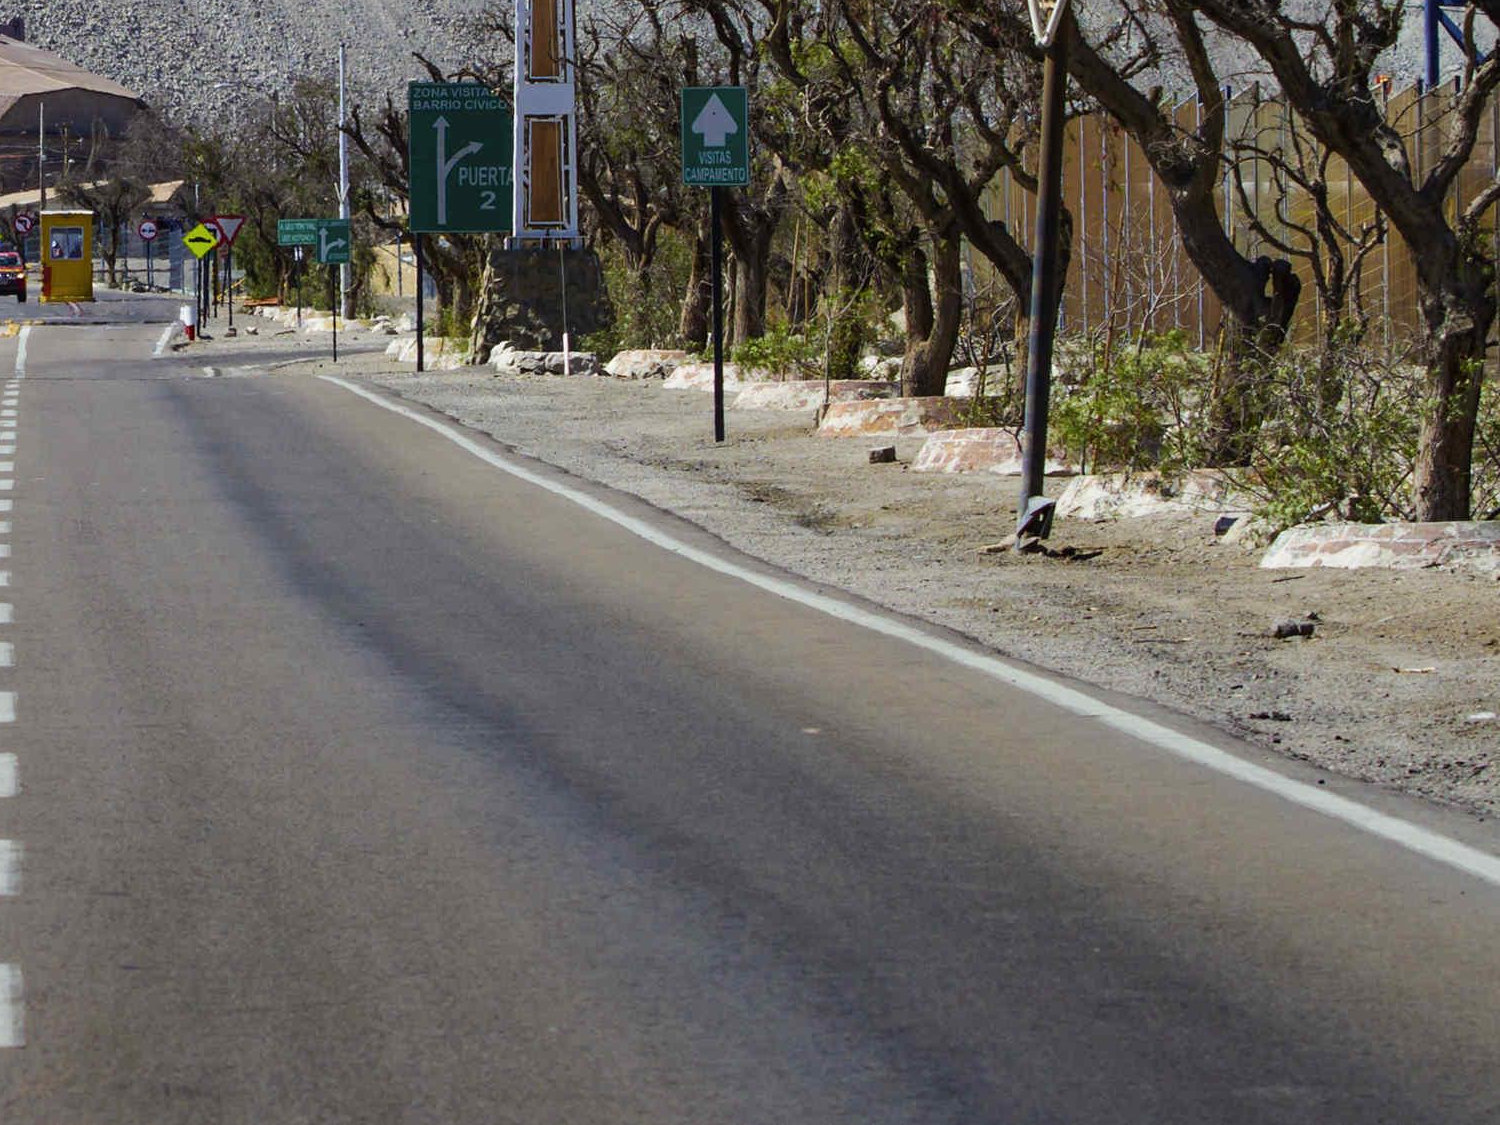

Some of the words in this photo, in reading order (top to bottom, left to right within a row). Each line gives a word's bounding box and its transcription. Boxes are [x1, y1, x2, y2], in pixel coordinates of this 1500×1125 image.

[412, 87, 449, 98] ZONA
[451, 87, 491, 98] VISITA
[412, 100, 461, 110] BARRIO
[698, 150, 732, 164] VISITAS
[684, 167, 746, 181] CAMPAMENTO
[479, 191, 496, 210] 2
